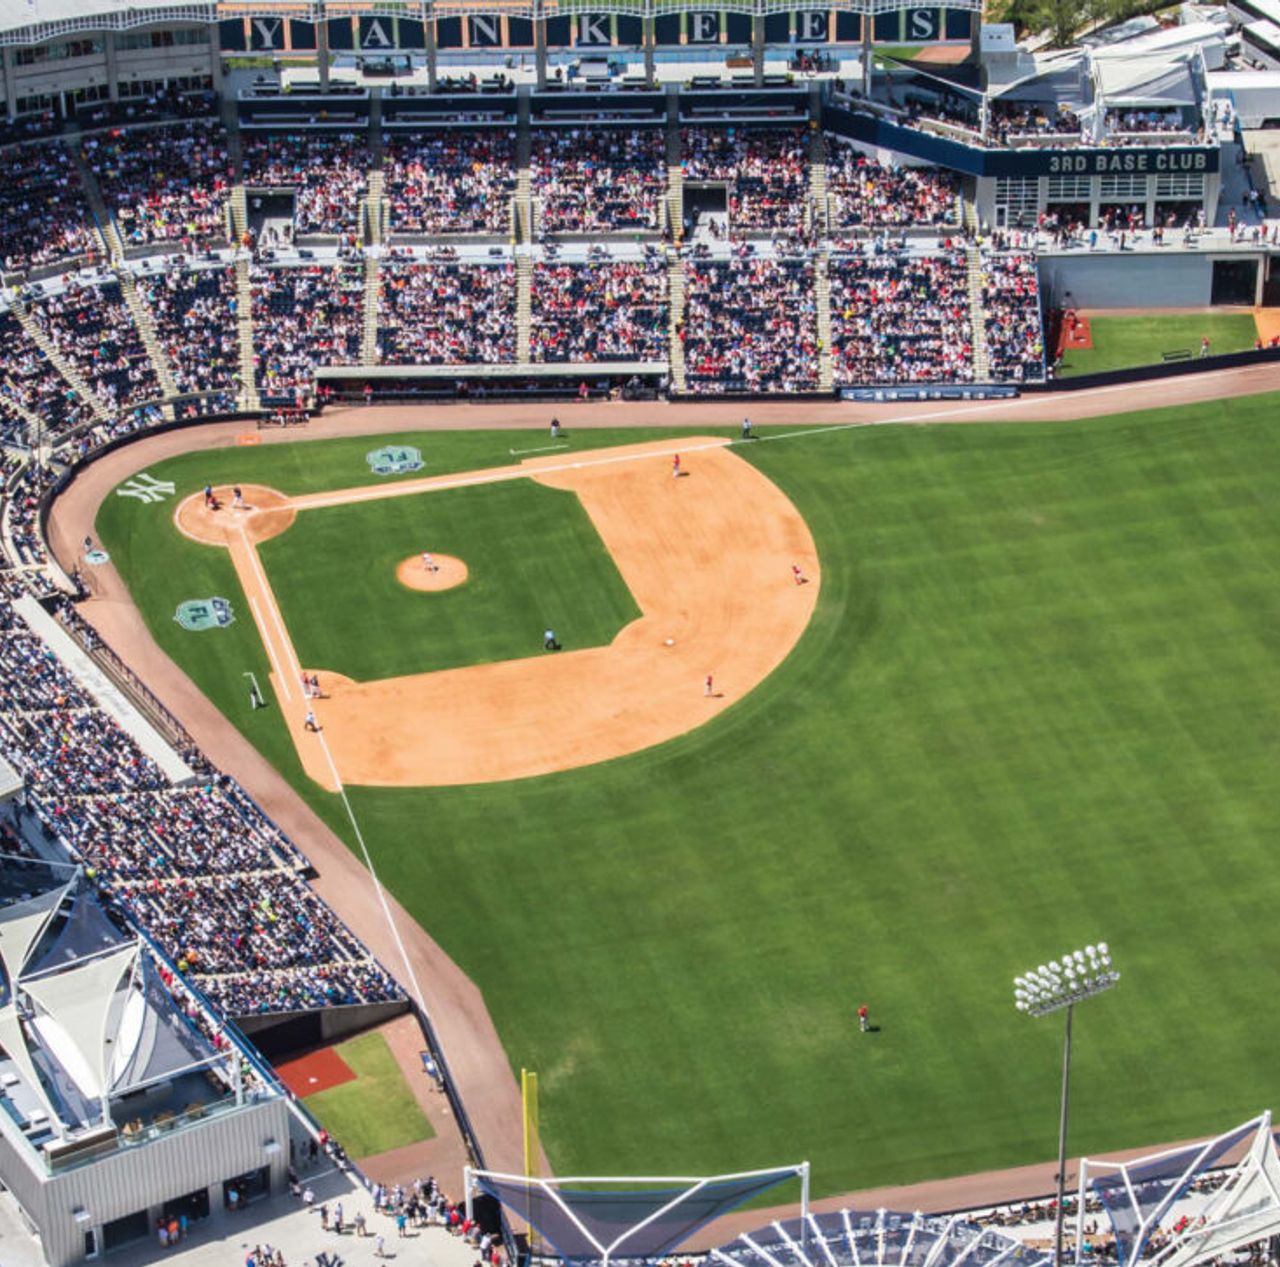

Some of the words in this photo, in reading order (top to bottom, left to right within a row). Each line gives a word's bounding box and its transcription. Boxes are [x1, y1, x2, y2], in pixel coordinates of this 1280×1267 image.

[252, 9, 934, 49] YANKEES
[1049, 156, 1087, 172] 3RD
[1096, 154, 1148, 171] BASE
[1156, 153, 1207, 170] CLUB
